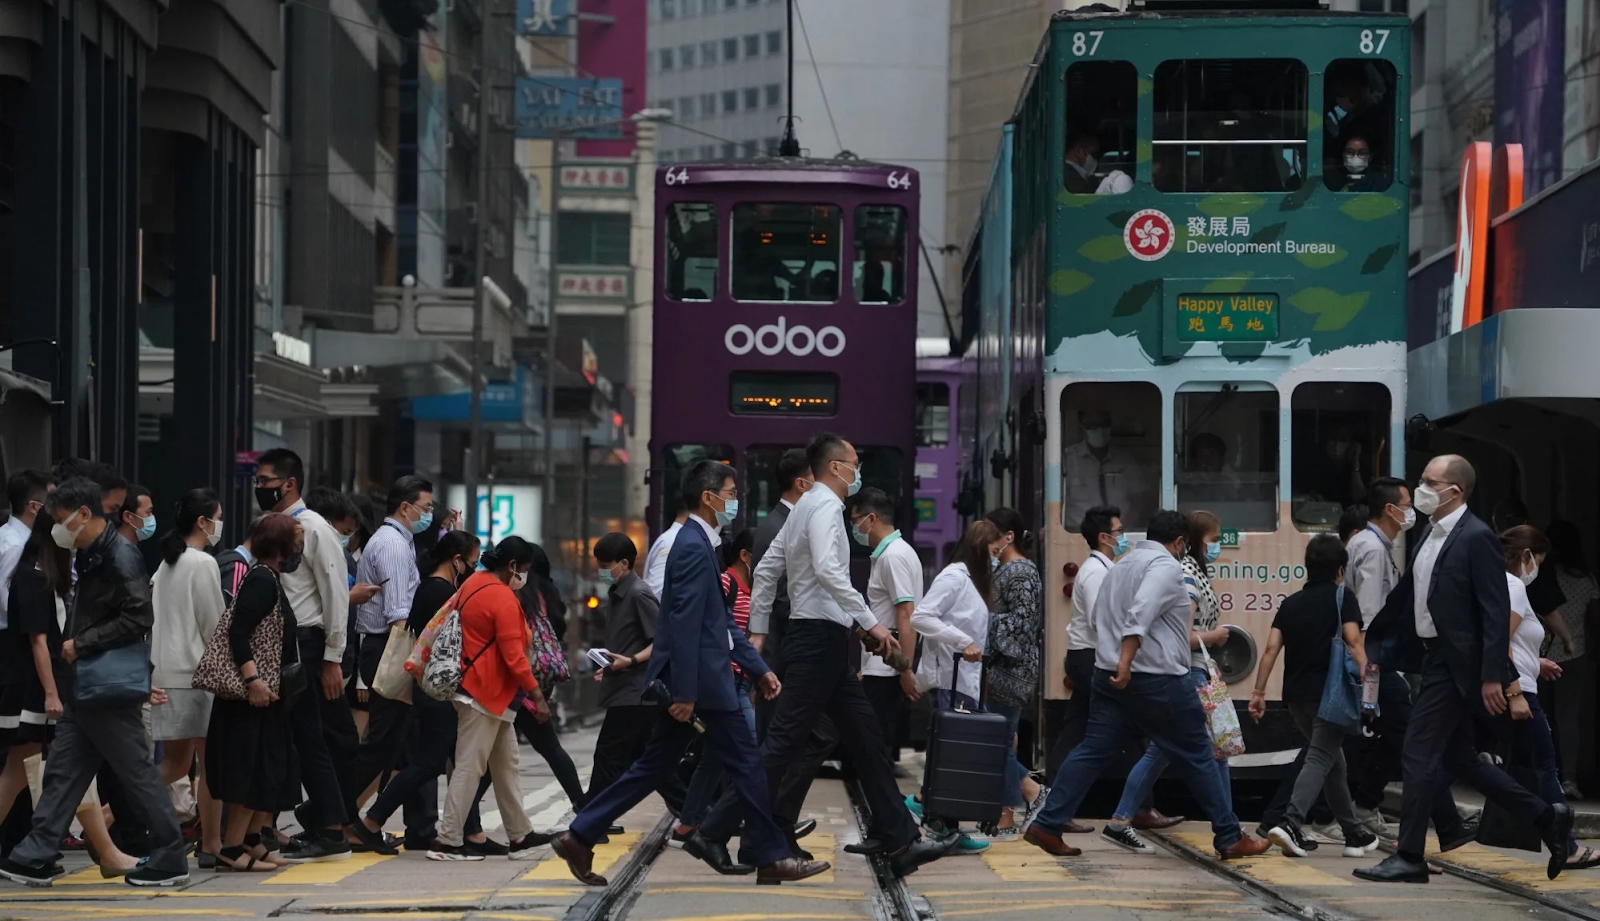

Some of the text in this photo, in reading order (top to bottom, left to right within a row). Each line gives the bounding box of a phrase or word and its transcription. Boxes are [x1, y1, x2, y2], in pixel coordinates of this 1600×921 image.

[1071, 31, 1104, 57] 87
[1359, 29, 1390, 54] 87
[665, 168, 690, 185] 64
[887, 171, 911, 189] 64
[1187, 216, 1250, 237] 發展局
[1186, 240, 1335, 256] Development Bureau
[1178, 296, 1274, 314] Happy Valley
[1188, 316, 1264, 332] 跑馬地
[724, 315, 846, 357] odoo
[1219, 533, 1236, 544] 36
[1220, 593, 1233, 611] 8
